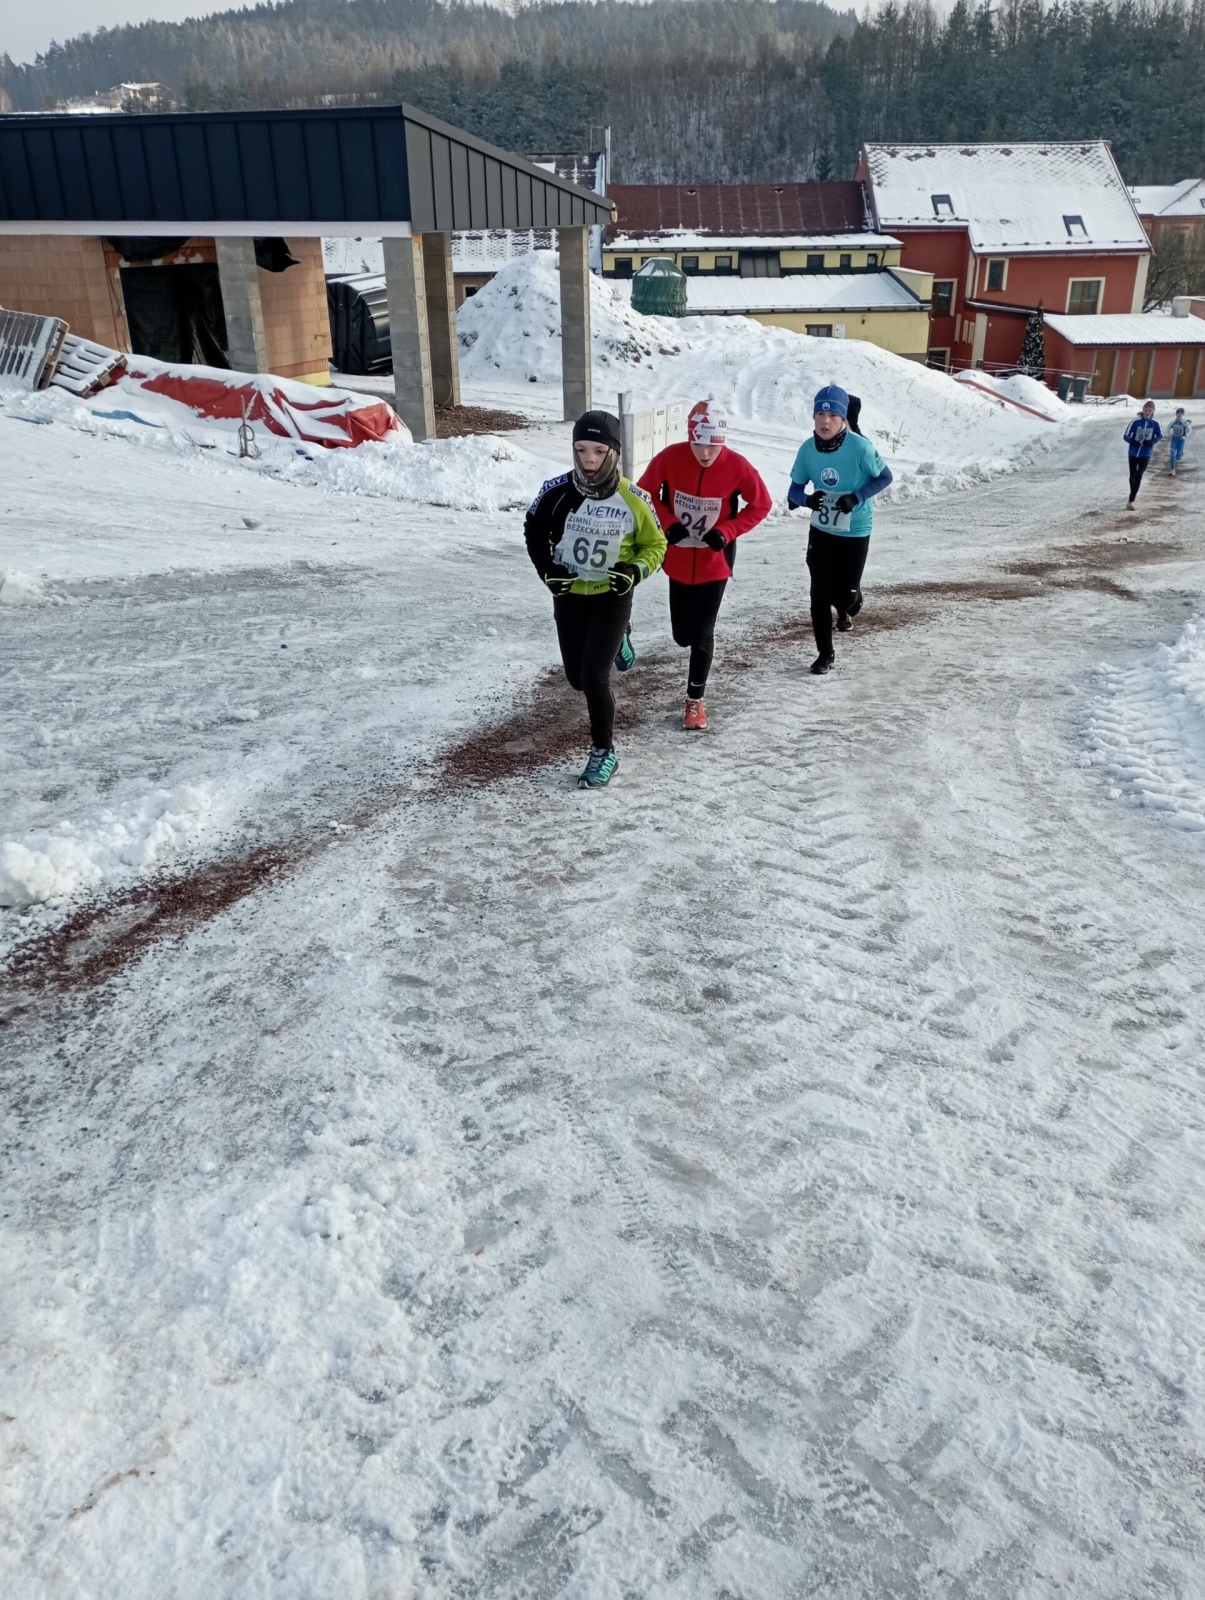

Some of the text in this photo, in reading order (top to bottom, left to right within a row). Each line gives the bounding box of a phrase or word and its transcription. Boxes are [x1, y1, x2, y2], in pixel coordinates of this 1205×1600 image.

[676, 492, 694, 503] ZIMNÍ
[567, 515, 592, 526] ZIMNÍ
[681, 512, 707, 537] 24
[818, 505, 842, 526] 87
[566, 522, 600, 536] BĚŽECKÁ
[603, 529, 620, 537] LIGA
[573, 536, 609, 569] 65
